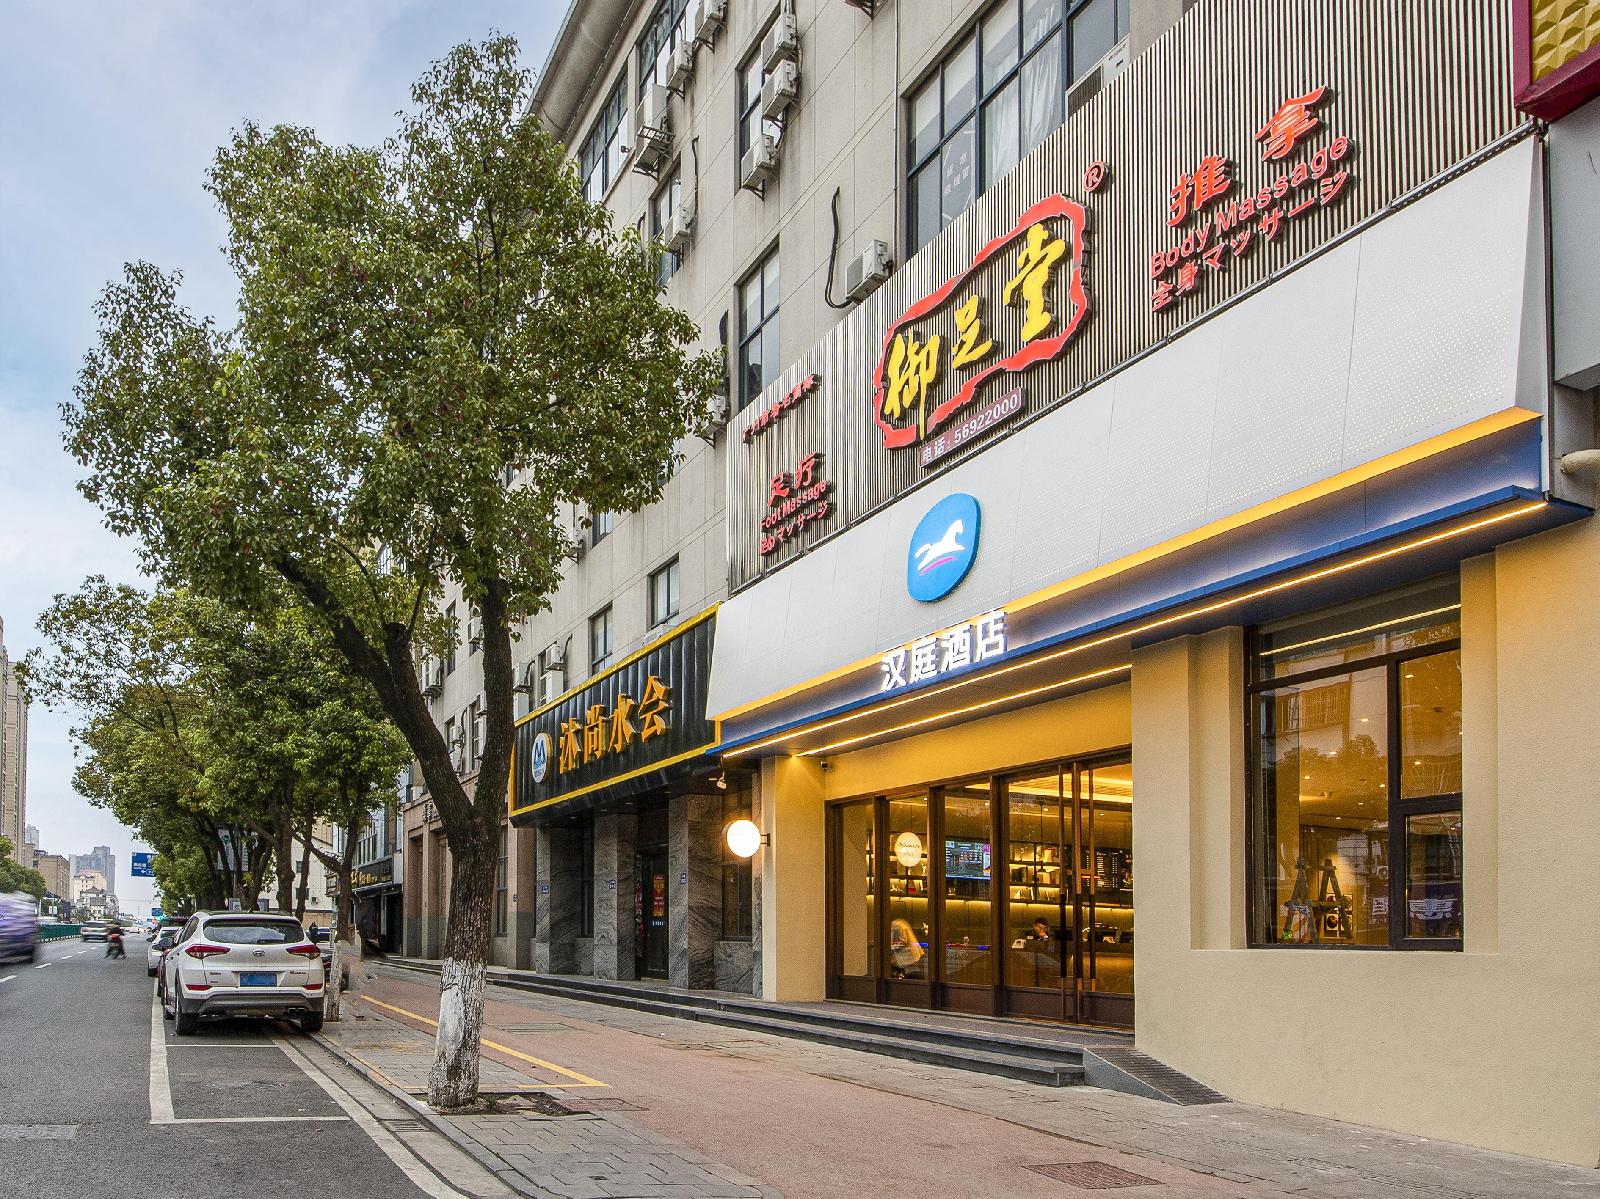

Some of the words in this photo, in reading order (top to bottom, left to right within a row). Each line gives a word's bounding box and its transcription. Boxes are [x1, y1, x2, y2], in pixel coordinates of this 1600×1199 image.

[1150, 222, 1210, 279] Body
[1215, 135, 1347, 236] Massage
[1167, 85, 1327, 227] 推拿
[1150, 170, 1348, 313] 全身マッサージ
[884, 222, 1066, 440] 御足堂
[783, 479, 827, 517] Massage
[880, 608, 1008, 692] 汉庭酒店
[559, 675, 671, 775] 沐尚水会
